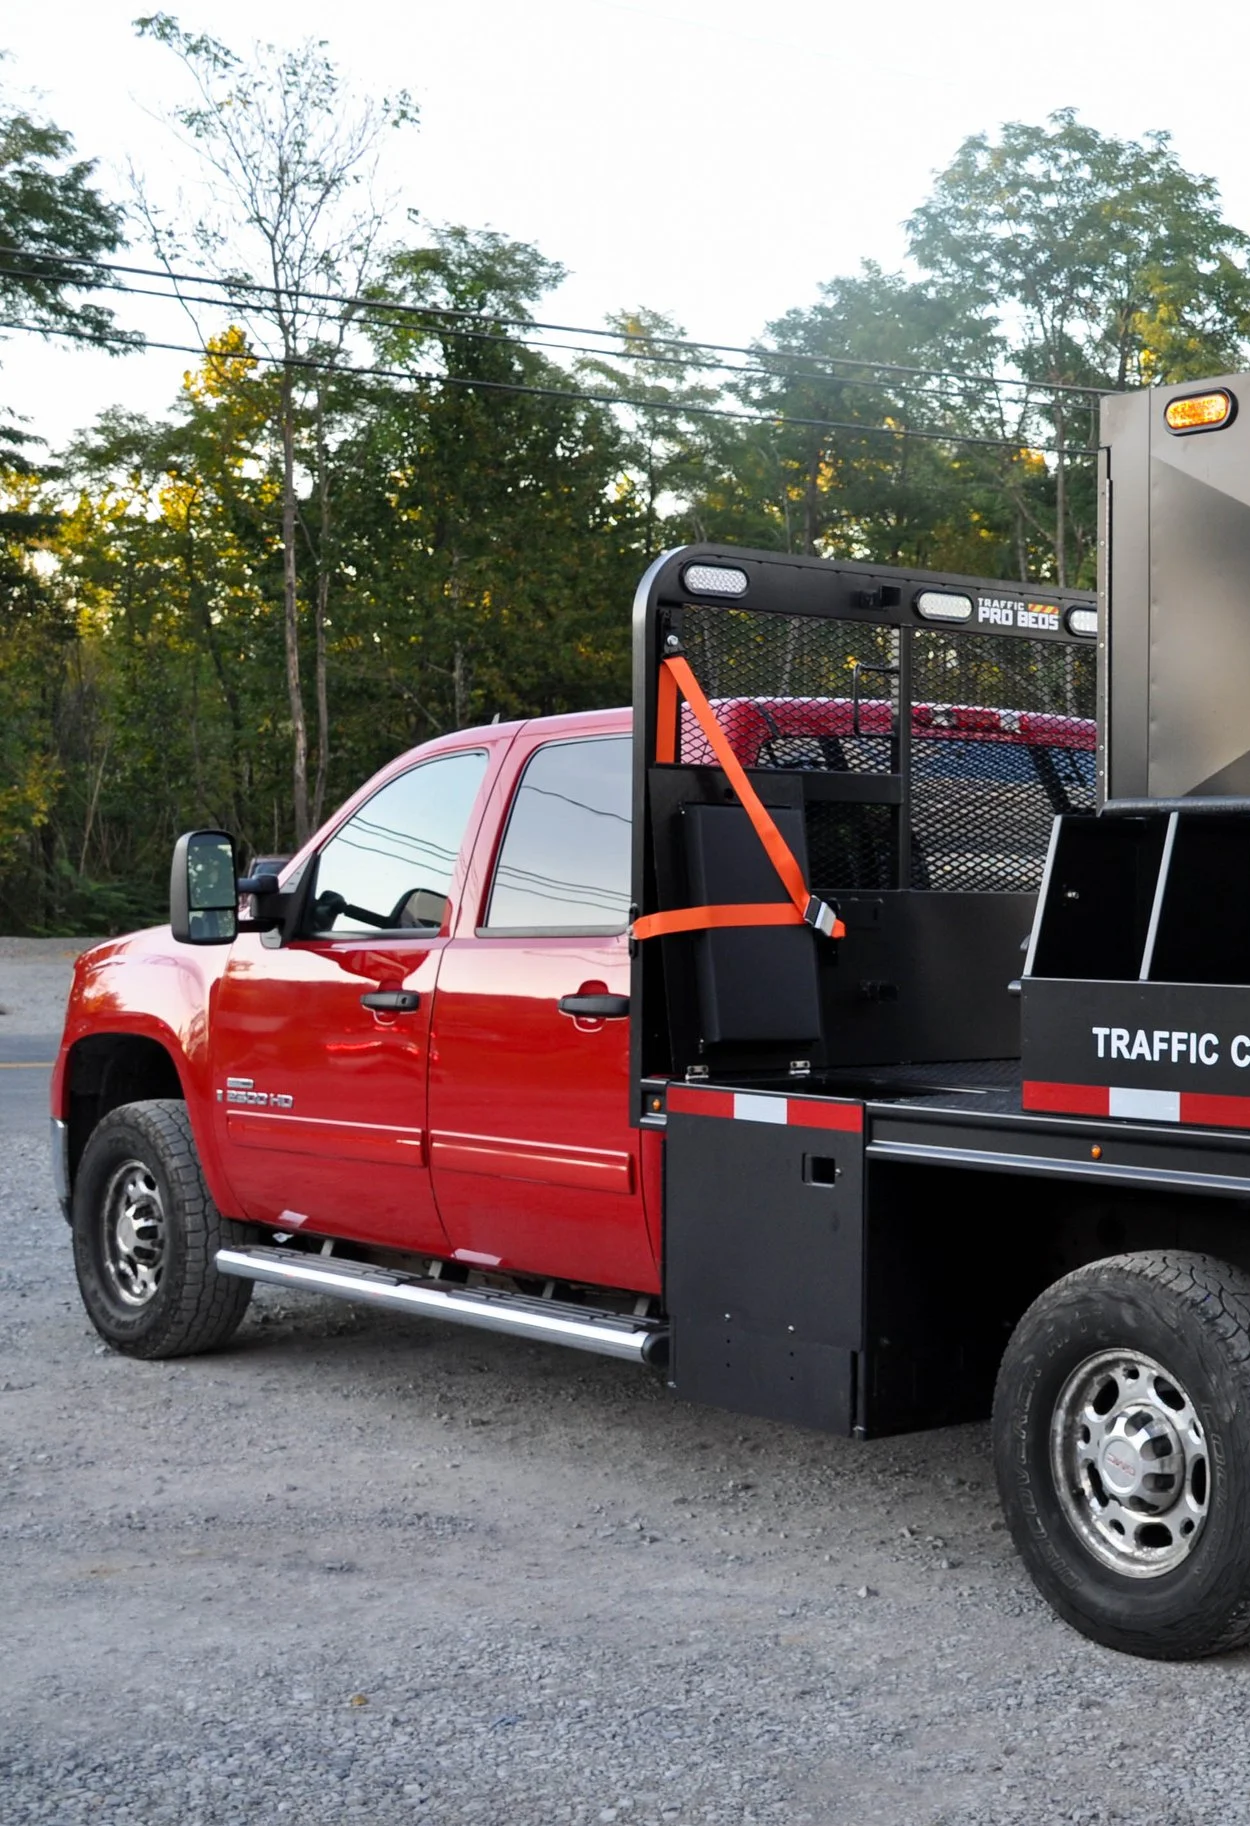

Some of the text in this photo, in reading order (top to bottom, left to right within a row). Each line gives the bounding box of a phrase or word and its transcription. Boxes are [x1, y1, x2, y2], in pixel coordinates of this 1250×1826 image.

[977, 597, 1025, 611] TRAFFIC
[978, 606, 1059, 630] PRO BEDS
[1092, 1027, 1219, 1066] TRAFFIC
[269, 1093, 293, 1108] HD
